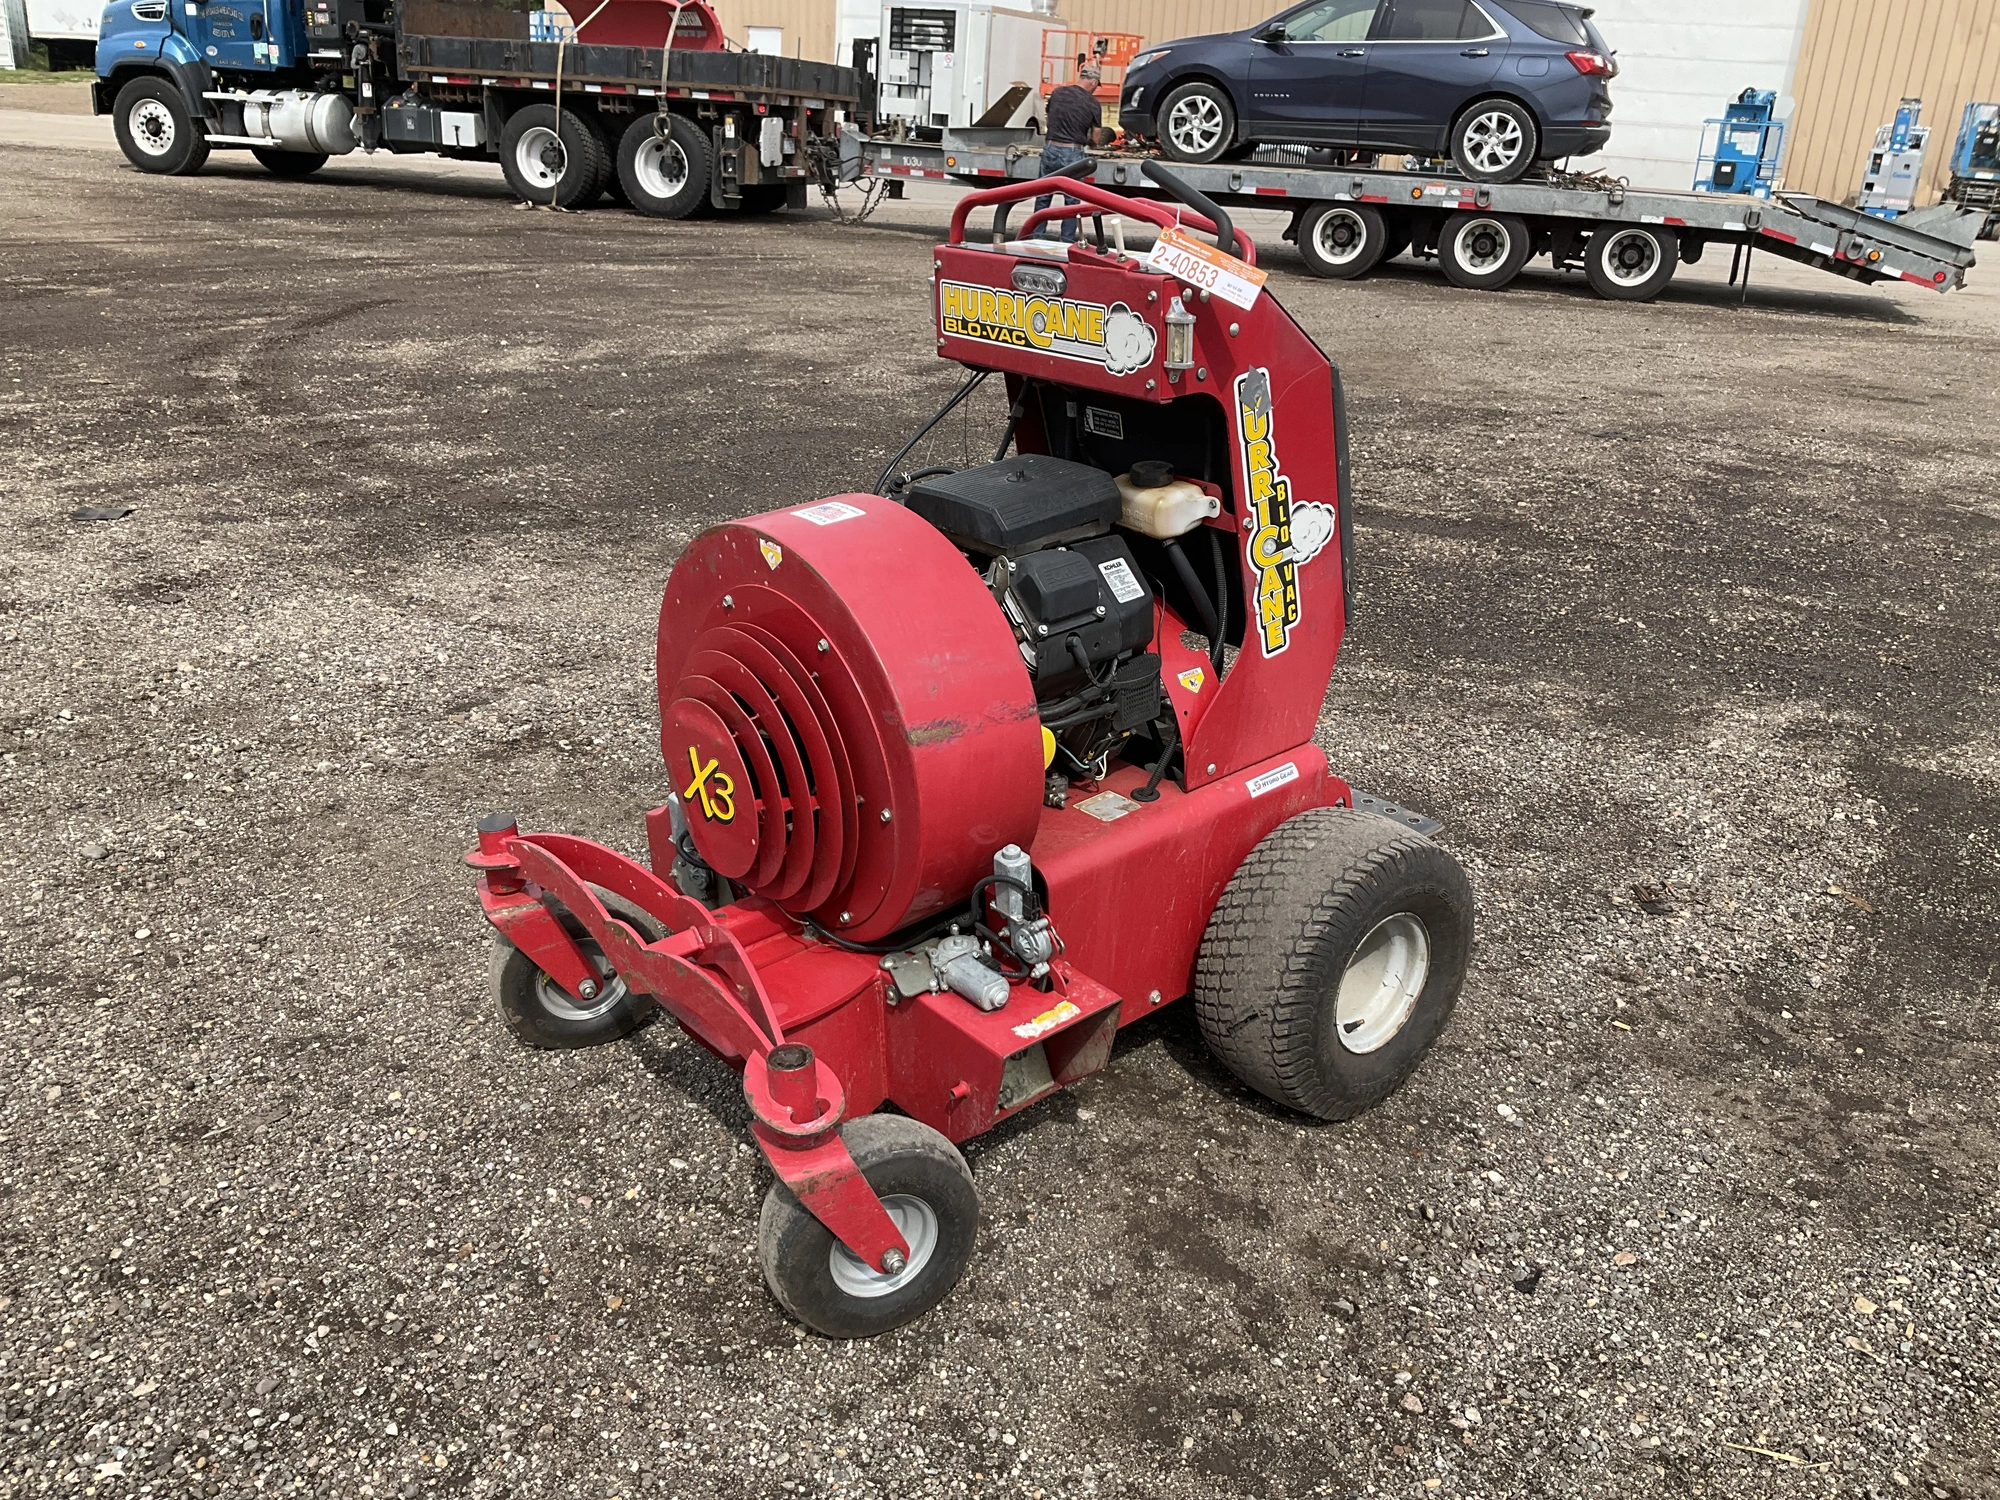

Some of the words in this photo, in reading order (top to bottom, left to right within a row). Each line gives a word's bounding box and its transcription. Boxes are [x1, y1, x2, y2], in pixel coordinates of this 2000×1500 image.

[1152, 245, 1219, 288] 2-40853
[943, 285, 1104, 348] HURRICANE
[1242, 382, 1284, 649] URRICANE
[1103, 561, 1122, 571] KOHLER
[683, 746, 735, 820] X3
[1262, 776, 1280, 788] HYDRO
[1280, 769, 1295, 780] GEAR
